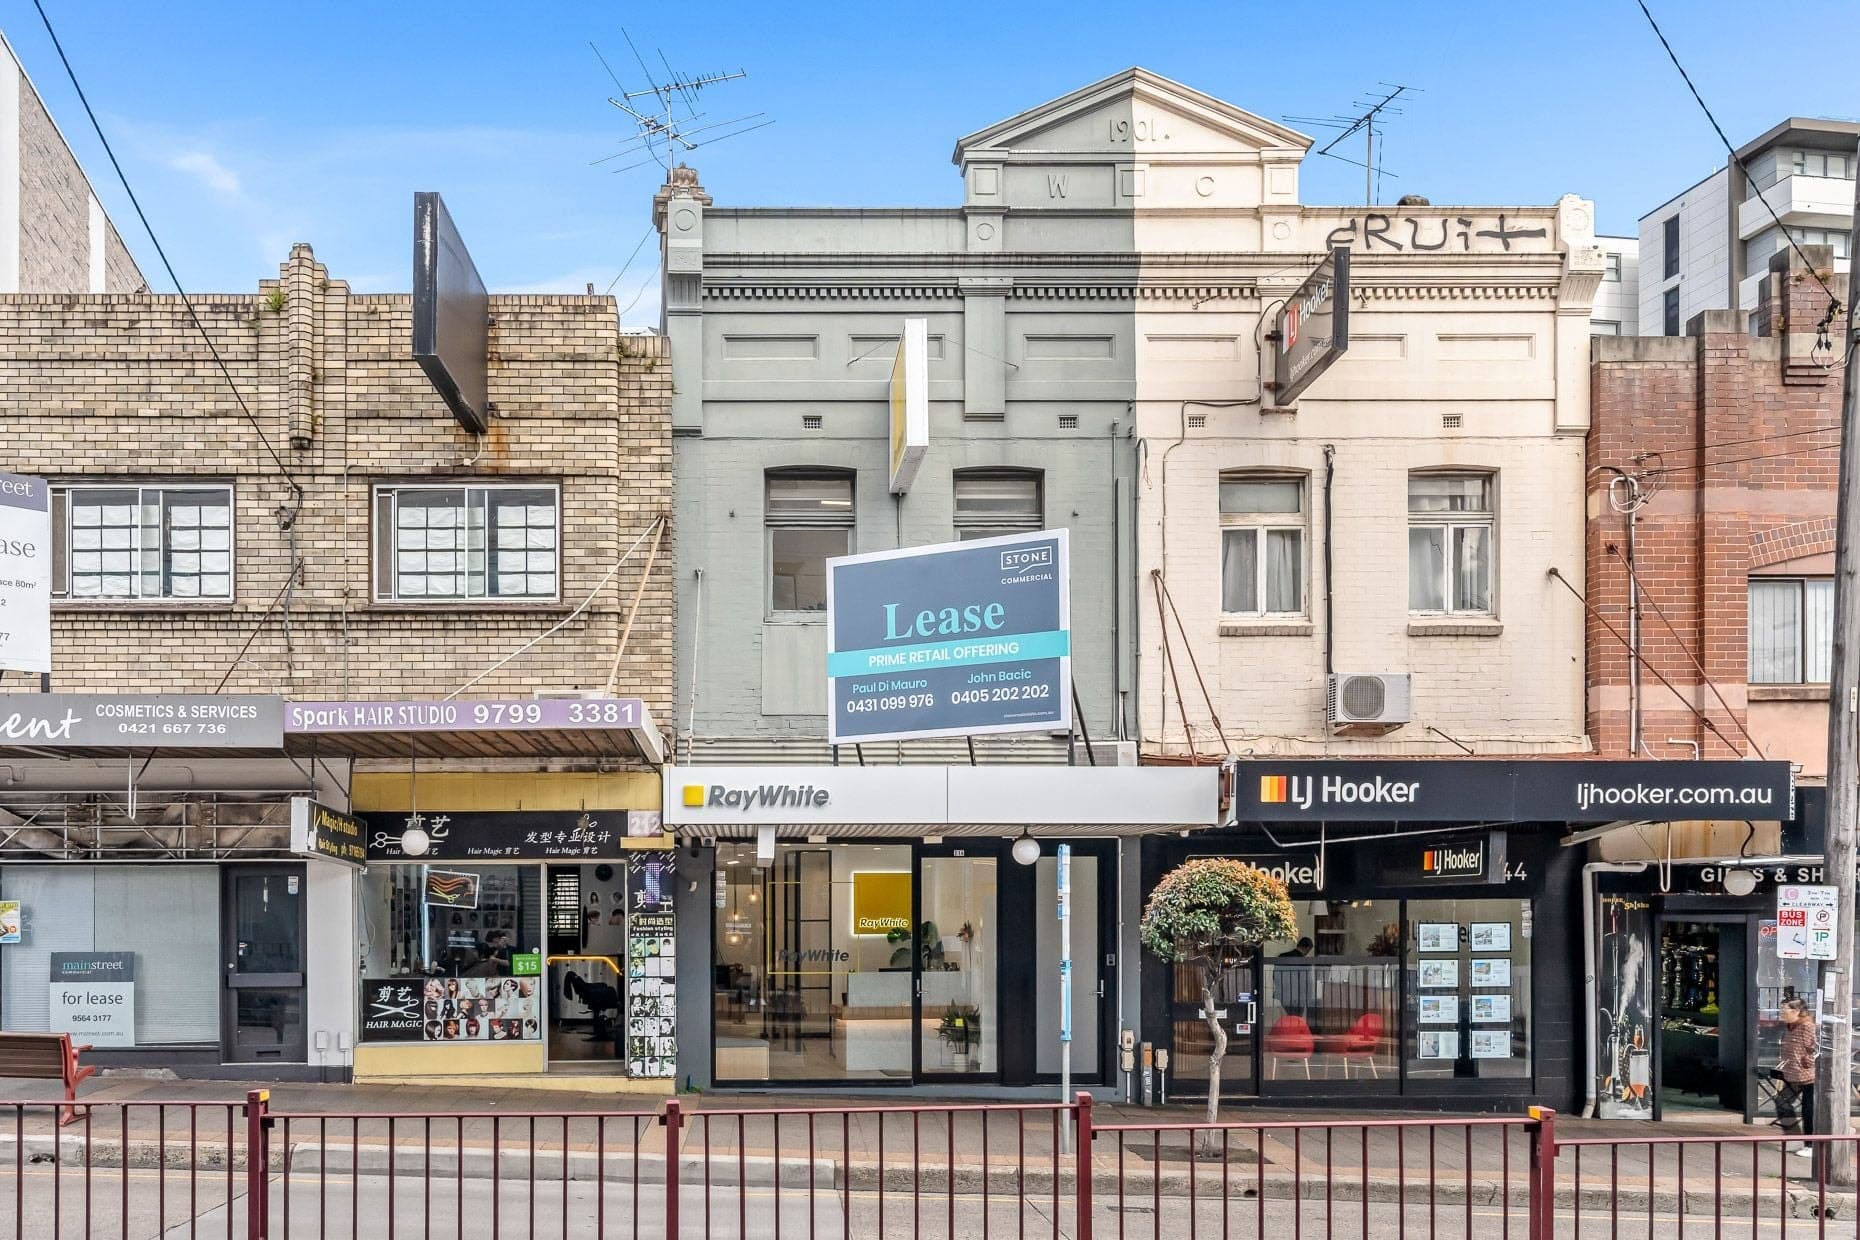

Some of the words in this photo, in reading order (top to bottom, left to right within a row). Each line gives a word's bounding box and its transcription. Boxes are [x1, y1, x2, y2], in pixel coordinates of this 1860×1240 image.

[1048, 174, 1069, 199] W
[1299, 278, 1330, 326] Hooker
[1006, 551, 1048, 565] STONE
[1001, 573, 1052, 585] COMMERCIAL
[883, 601, 1006, 641] Lease
[868, 653, 907, 668] PRIME
[909, 648, 951, 664] RETAIL
[953, 641, 1020, 659] OFFERING
[967, 671, 996, 684] John
[998, 668, 1032, 681] Bacic
[852, 682, 877, 694] Paul
[878, 681, 890, 692] Di
[891, 678, 928, 691] Mauro
[951, 689, 989, 704] 0405
[991, 687, 1019, 701] 202
[1021, 684, 1049, 698] 202
[847, 699, 877, 713] 0431
[880, 696, 907, 711] 099
[909, 693, 934, 709] 976
[95, 704, 175, 719] COSMETICS
[177, 705, 187, 718] &
[190, 705, 257, 719] SERVICES
[292, 707, 349, 731] Spark
[354, 706, 394, 726] HAIR
[398, 705, 457, 725] STUDIO
[473, 703, 542, 724] 9799
[568, 703, 634, 724] 3381
[118, 723, 156, 734] 0421
[163, 723, 190, 734] 667
[198, 723, 226, 734] 736
[708, 784, 830, 812] RayWhite
[1291, 775, 1313, 809] LJ
[1322, 775, 1420, 803] Hooker
[1576, 783, 1772, 810] ljhooker.com.au
[525, 830, 611, 844] 发型专业设计
[483, 848, 503, 857] Magic
[546, 847, 561, 855] Hair
[561, 847, 582, 856] Magic
[1434, 850, 1443, 875] LJ
[1444, 848, 1480, 870] Hooker
[1701, 867, 1765, 883] GIS
[1774, 867, 1787, 883] &
[1797, 867, 1824, 883] SH
[859, 917, 909, 929] RayWhite
[1815, 932, 1829, 942] 1P
[778, 950, 850, 963] RayWhite
[63, 959, 124, 970] mainstreet
[518, 961, 537, 971] $15
[62, 991, 83, 1005] for
[86, 991, 124, 1005] lease
[72, 1014, 91, 1022] 9564
[92, 1014, 112, 1022] 3177
[366, 1021, 389, 1029] HAIR
[391, 1020, 423, 1028] MAGIC
